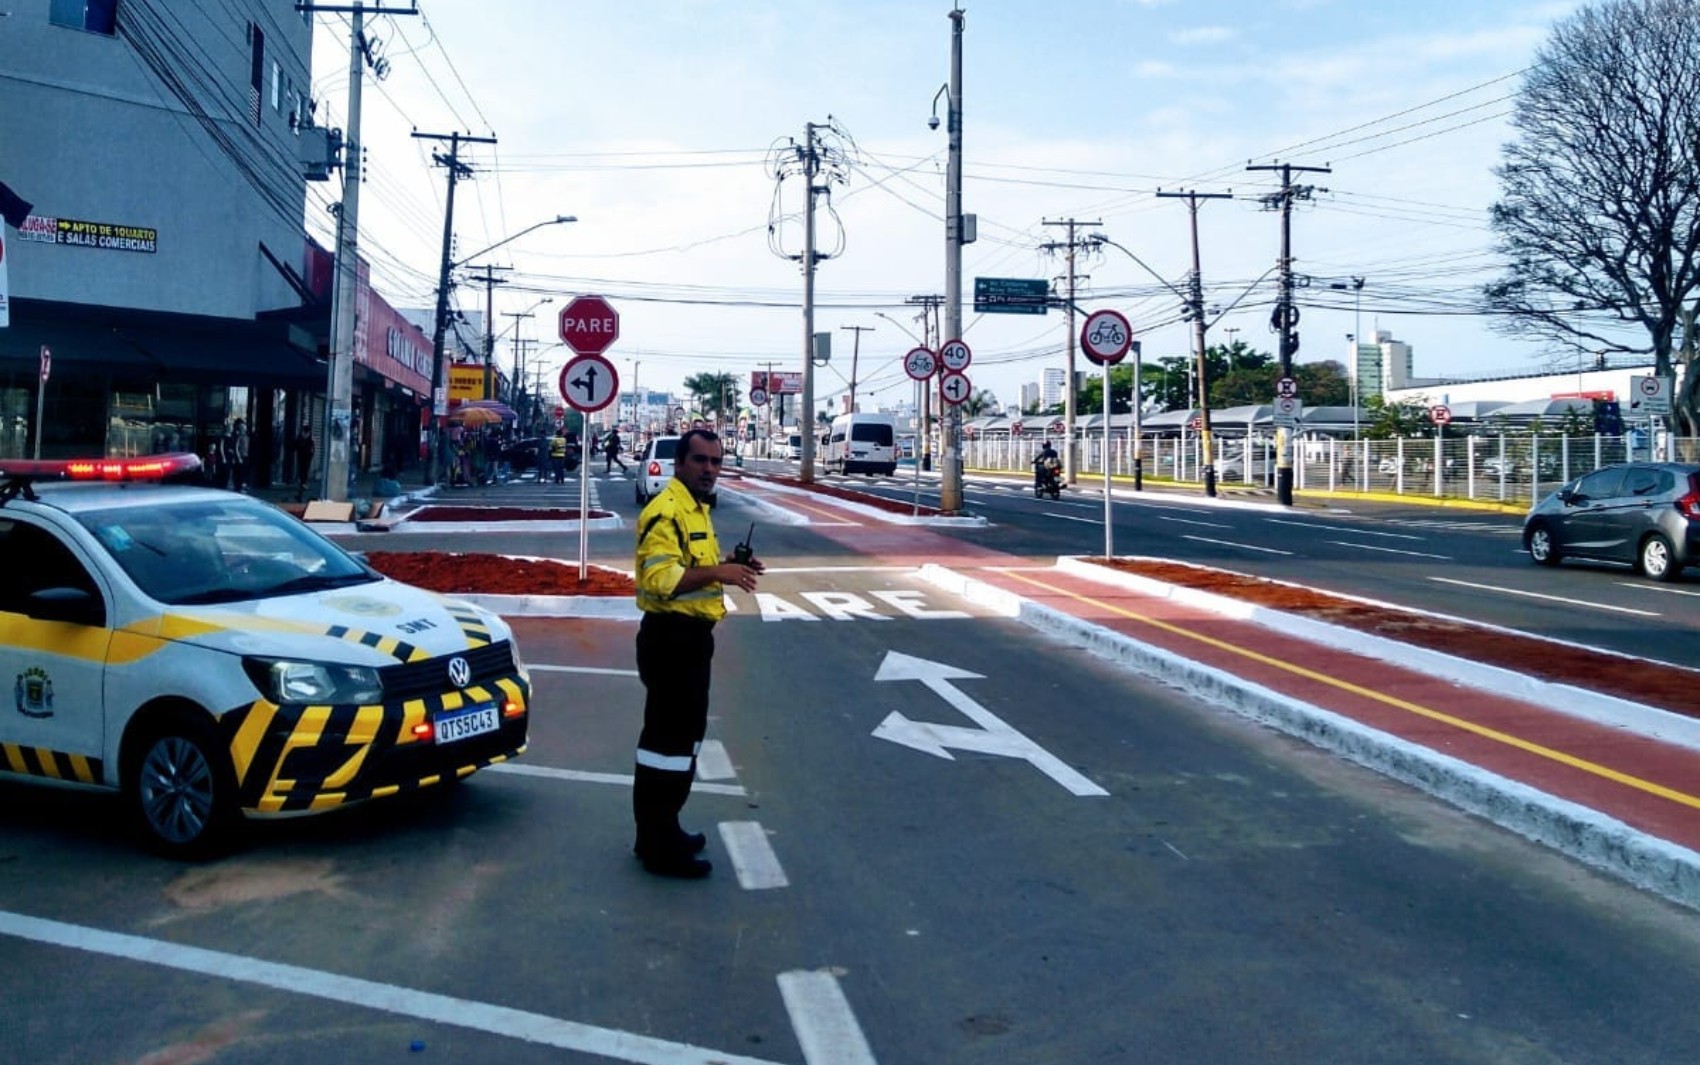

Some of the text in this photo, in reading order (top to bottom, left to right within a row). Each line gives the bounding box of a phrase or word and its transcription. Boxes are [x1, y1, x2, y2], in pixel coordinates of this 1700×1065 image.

[72, 223, 97, 233] APTO
[99, 225, 112, 235] DE
[57, 230, 65, 242] E
[66, 232, 97, 246] SALAS
[99, 236, 155, 251] COMERCIAIS
[564, 318, 613, 333] PARE
[944, 346, 966, 360] 40
[724, 589, 975, 622] ARE
[396, 619, 437, 634] SMT
[441, 710, 494, 740] QTS5C43
